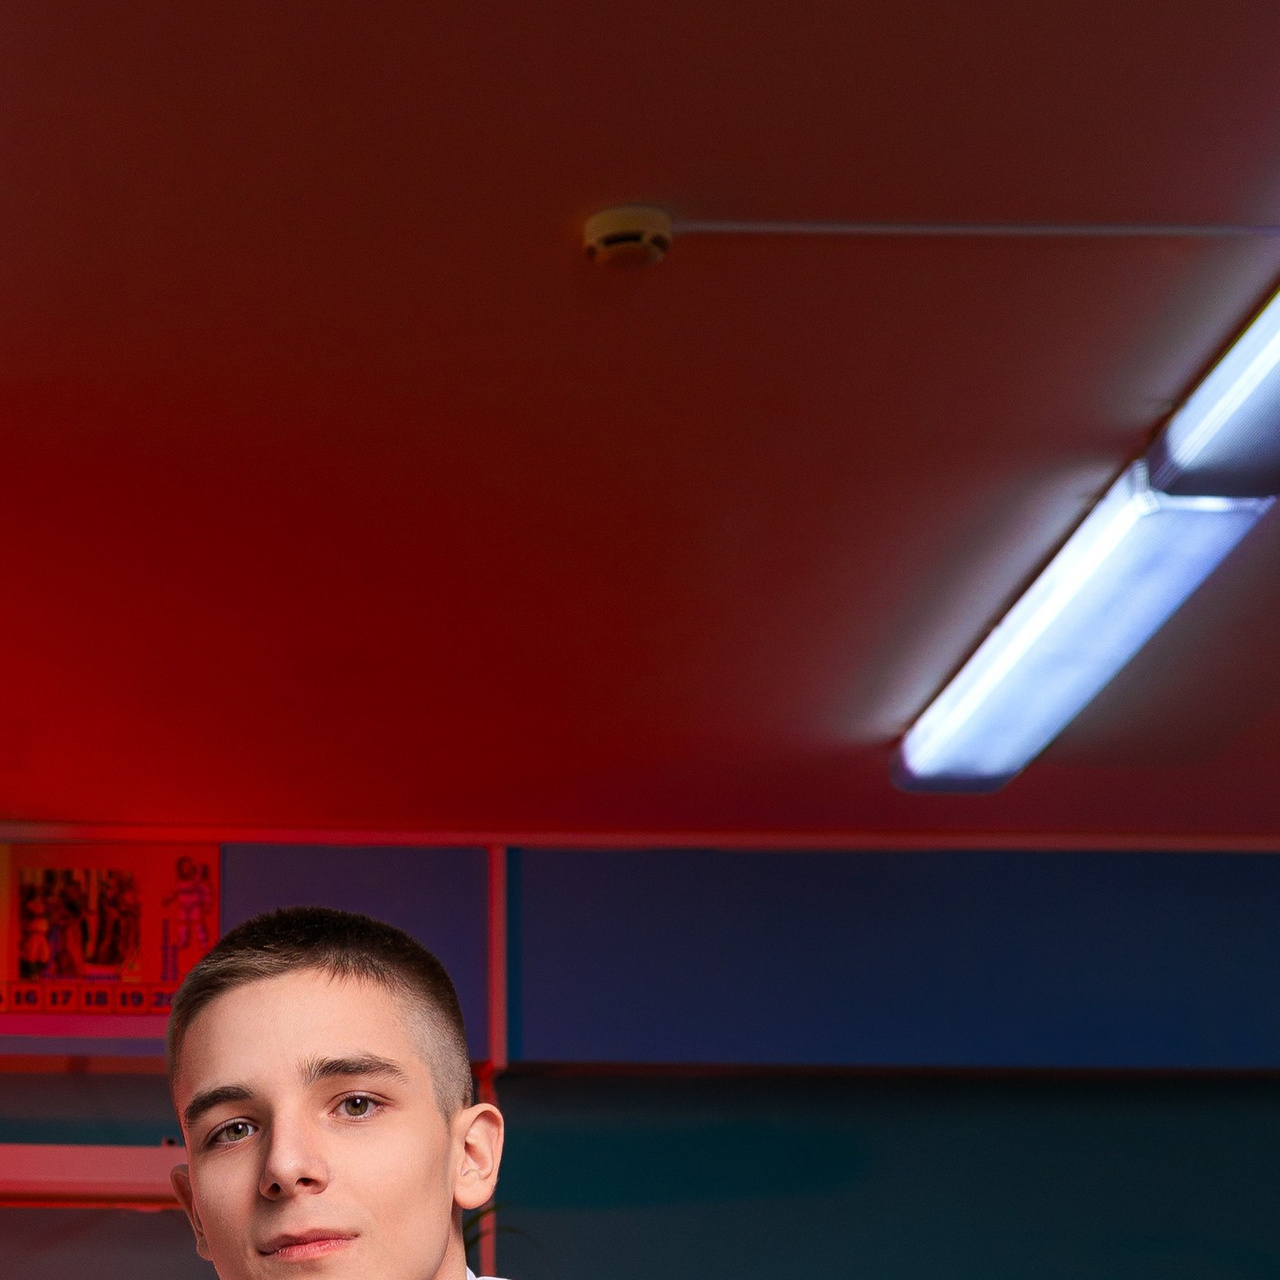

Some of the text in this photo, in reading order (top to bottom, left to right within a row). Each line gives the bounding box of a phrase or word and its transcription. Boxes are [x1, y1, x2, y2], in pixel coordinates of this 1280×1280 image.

[14, 989, 38, 1006] 16
[49, 990, 73, 1006] 17
[84, 990, 108, 1006] 18
[120, 990, 144, 1007] 19
